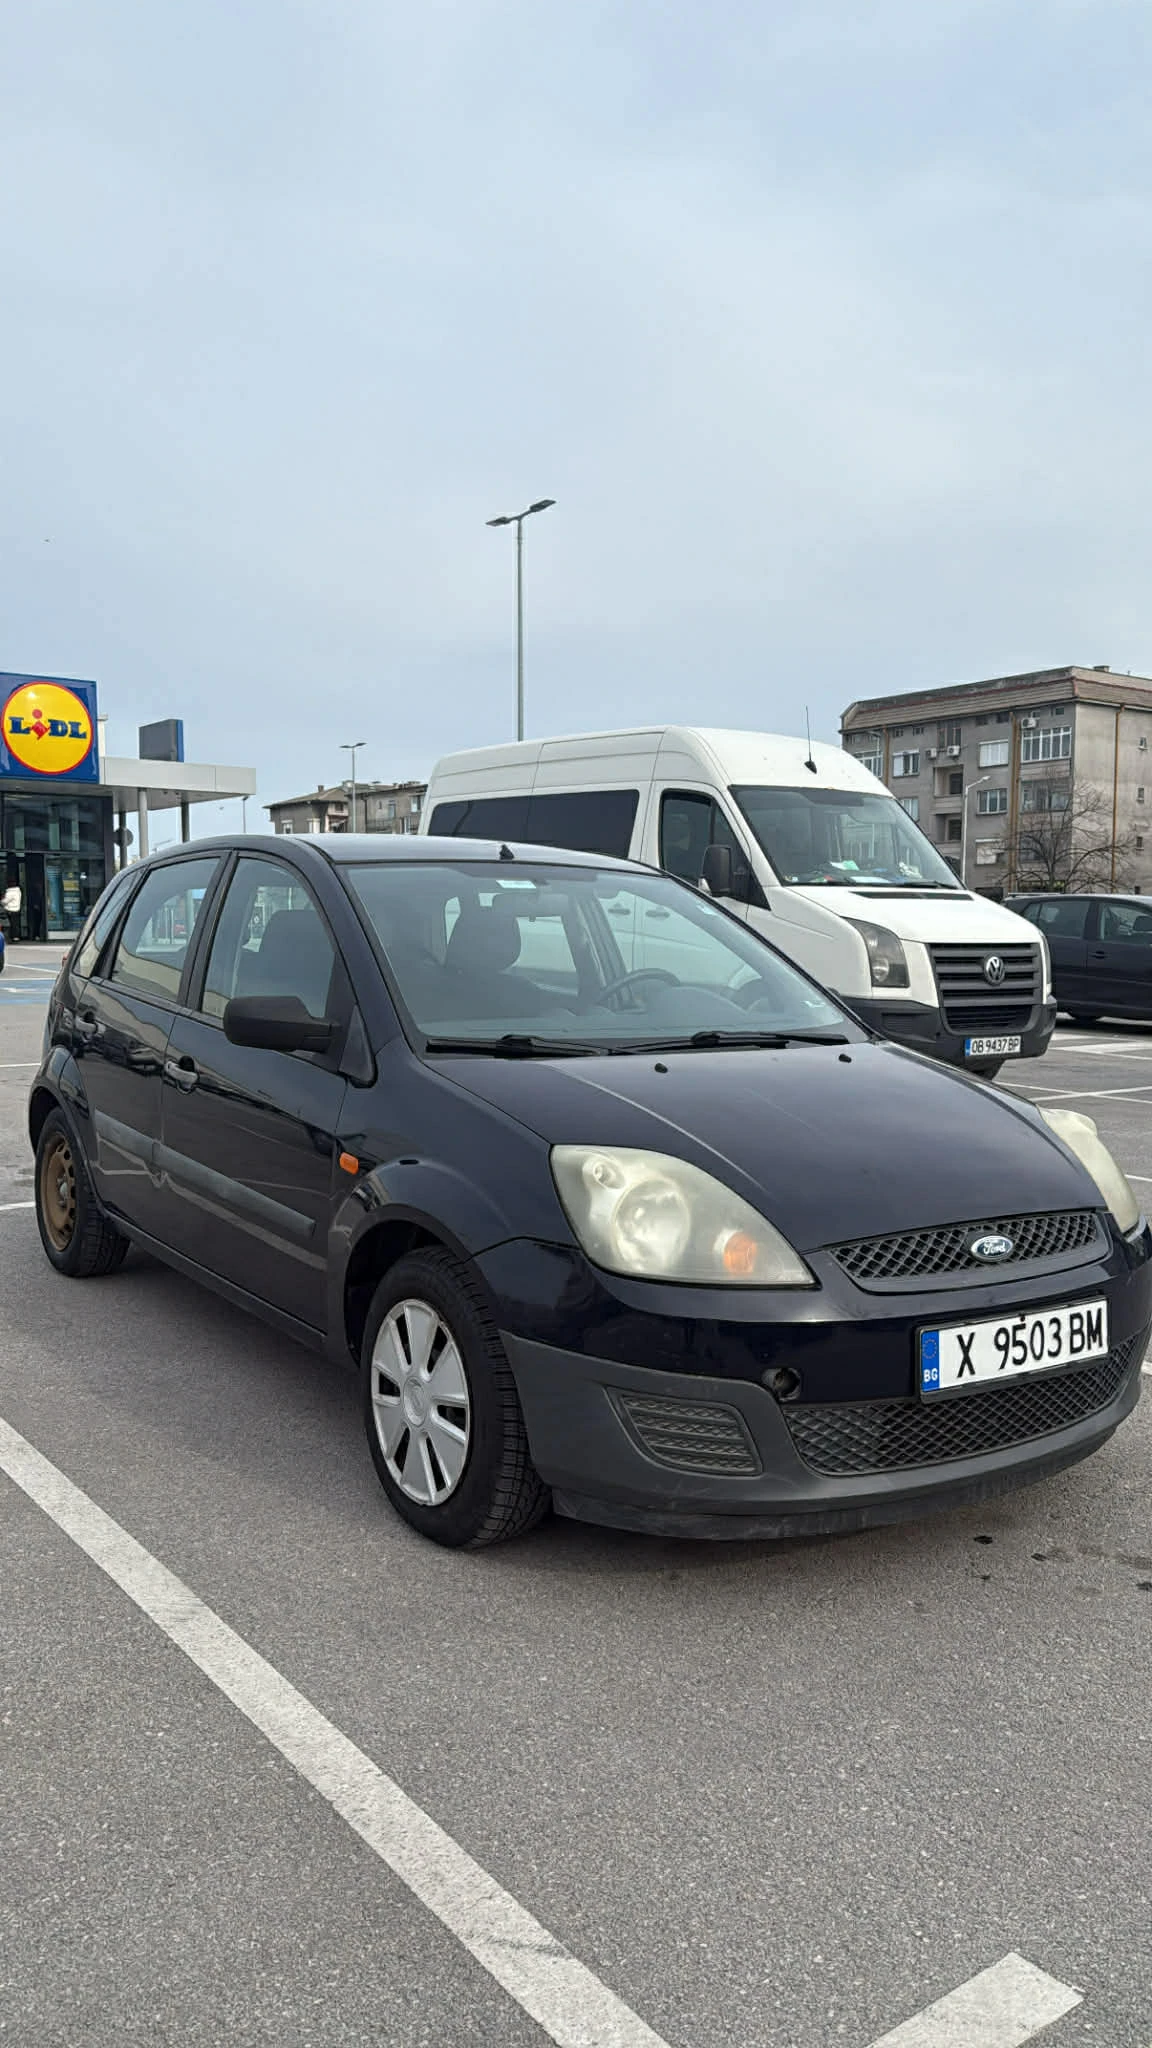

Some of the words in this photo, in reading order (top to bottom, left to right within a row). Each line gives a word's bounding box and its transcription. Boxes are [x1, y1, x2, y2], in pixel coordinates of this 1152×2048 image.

[983, 1240, 1006, 1255] Ford
[956, 1331, 976, 1379] X
[994, 1317, 1062, 1371] 9503
[1069, 1307, 1103, 1354] BM
[923, 1368, 938, 1383] BG
